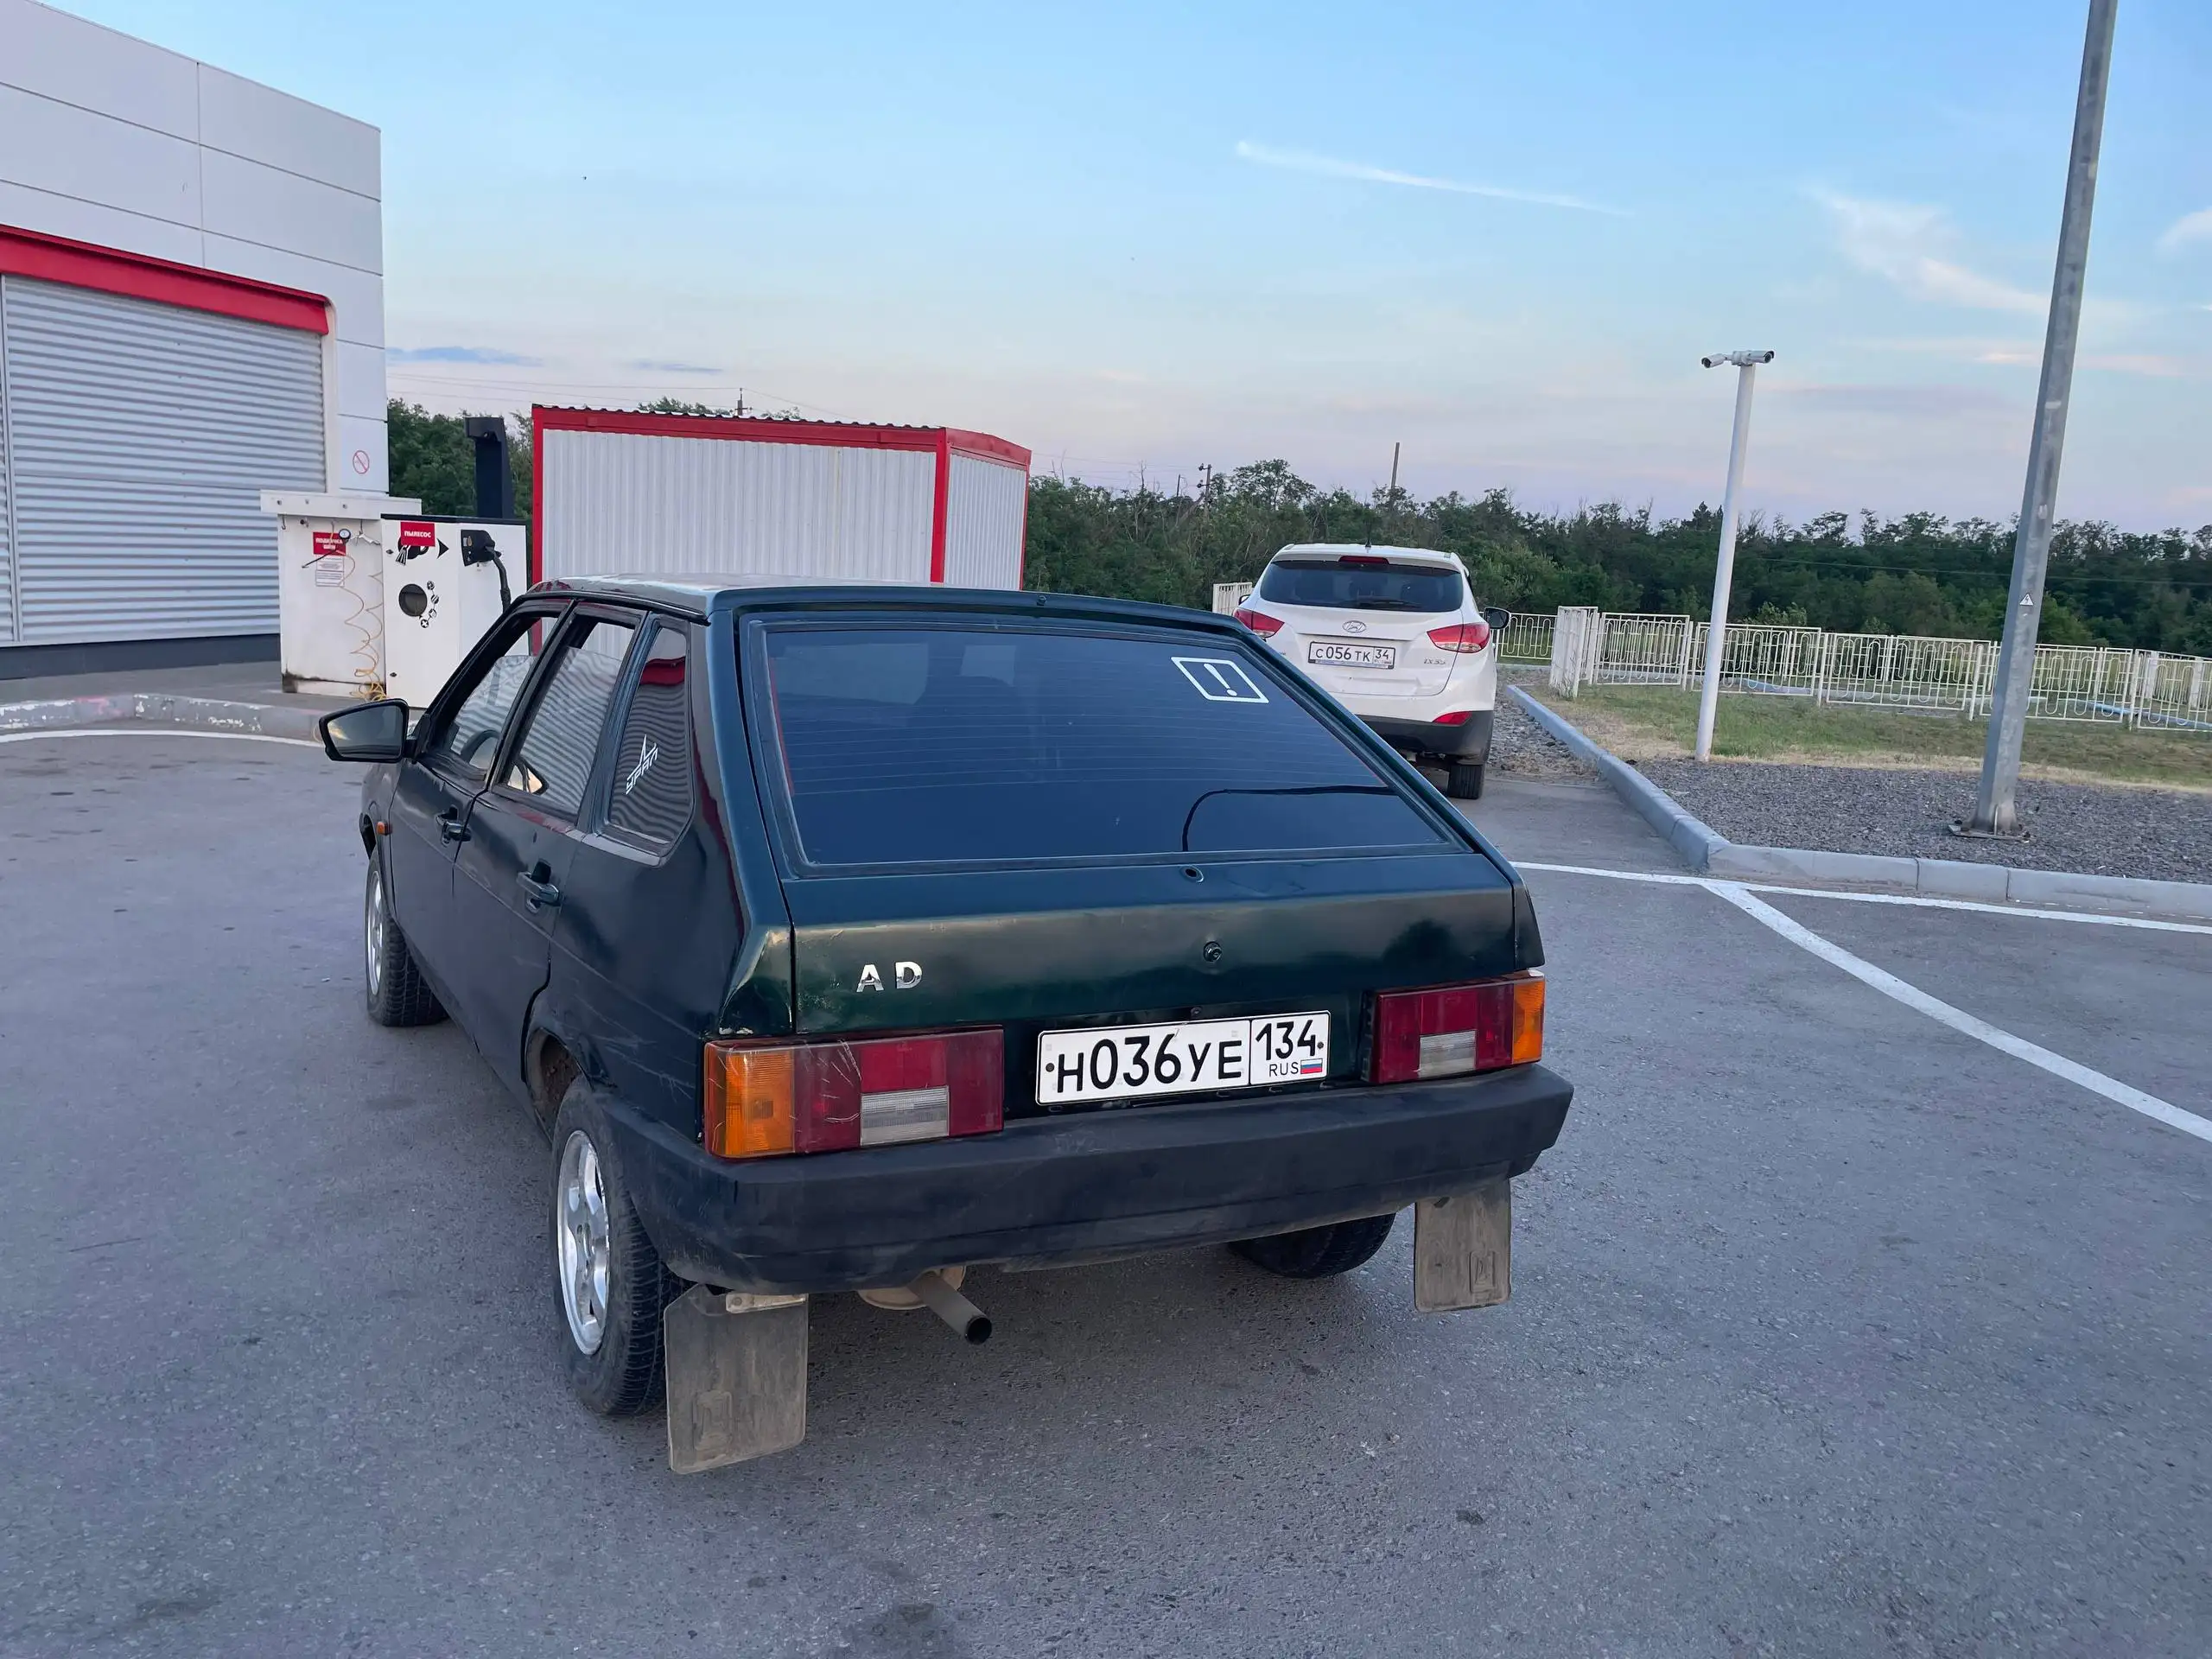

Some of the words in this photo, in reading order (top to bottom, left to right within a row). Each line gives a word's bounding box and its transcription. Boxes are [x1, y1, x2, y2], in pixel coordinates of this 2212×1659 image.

[1375, 649, 1389, 661] 34
[1255, 1020, 1316, 1061] 134
[1269, 1061, 1299, 1077] RUS
